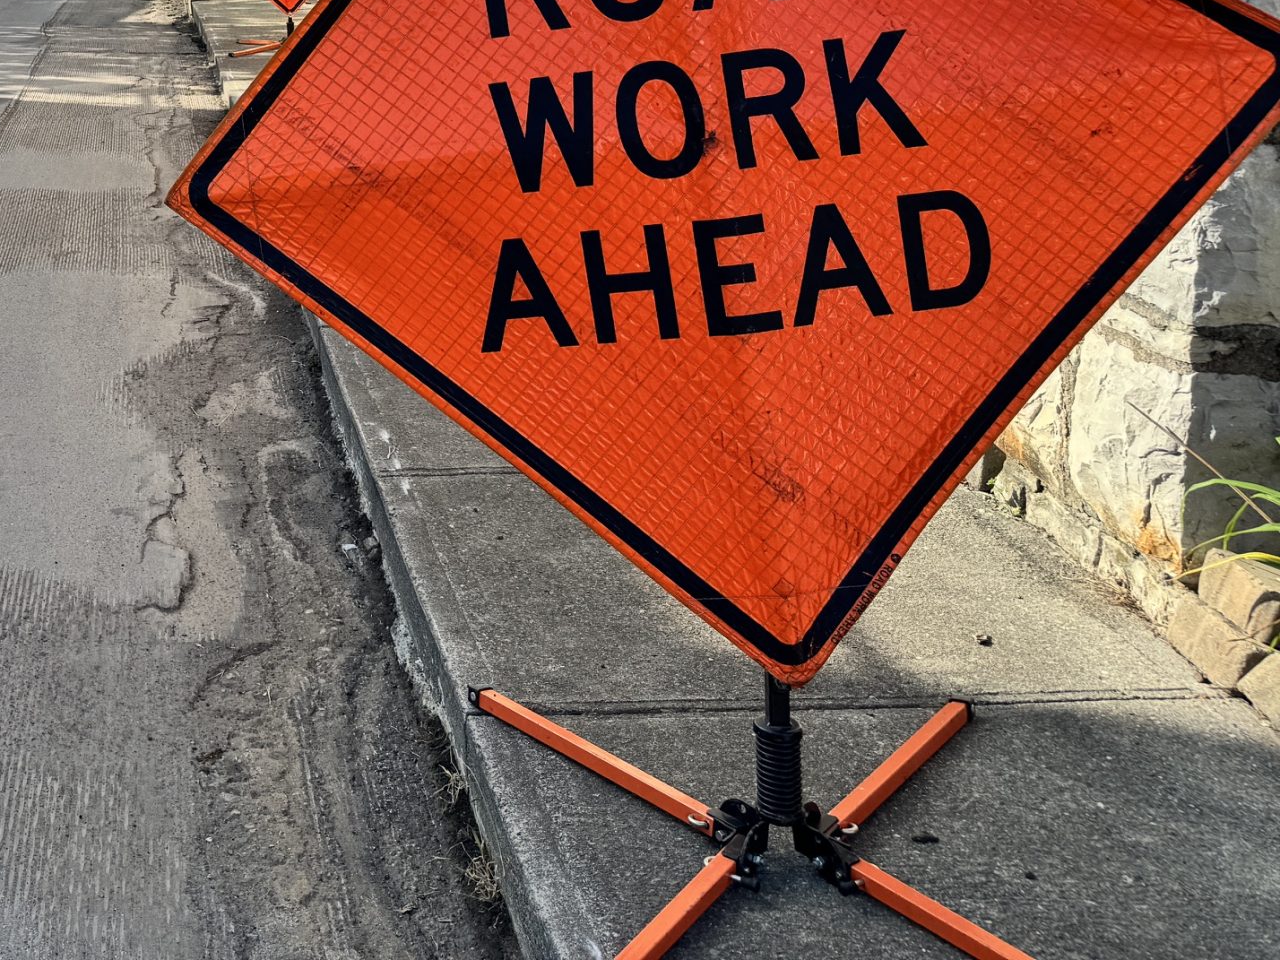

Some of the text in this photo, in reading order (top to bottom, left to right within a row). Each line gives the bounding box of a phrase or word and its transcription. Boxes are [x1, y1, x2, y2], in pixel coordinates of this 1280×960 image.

[488, 29, 929, 194] WORK
[481, 189, 992, 353] AHEAD
[830, 563, 893, 644] ROAD WORK AHEAD
